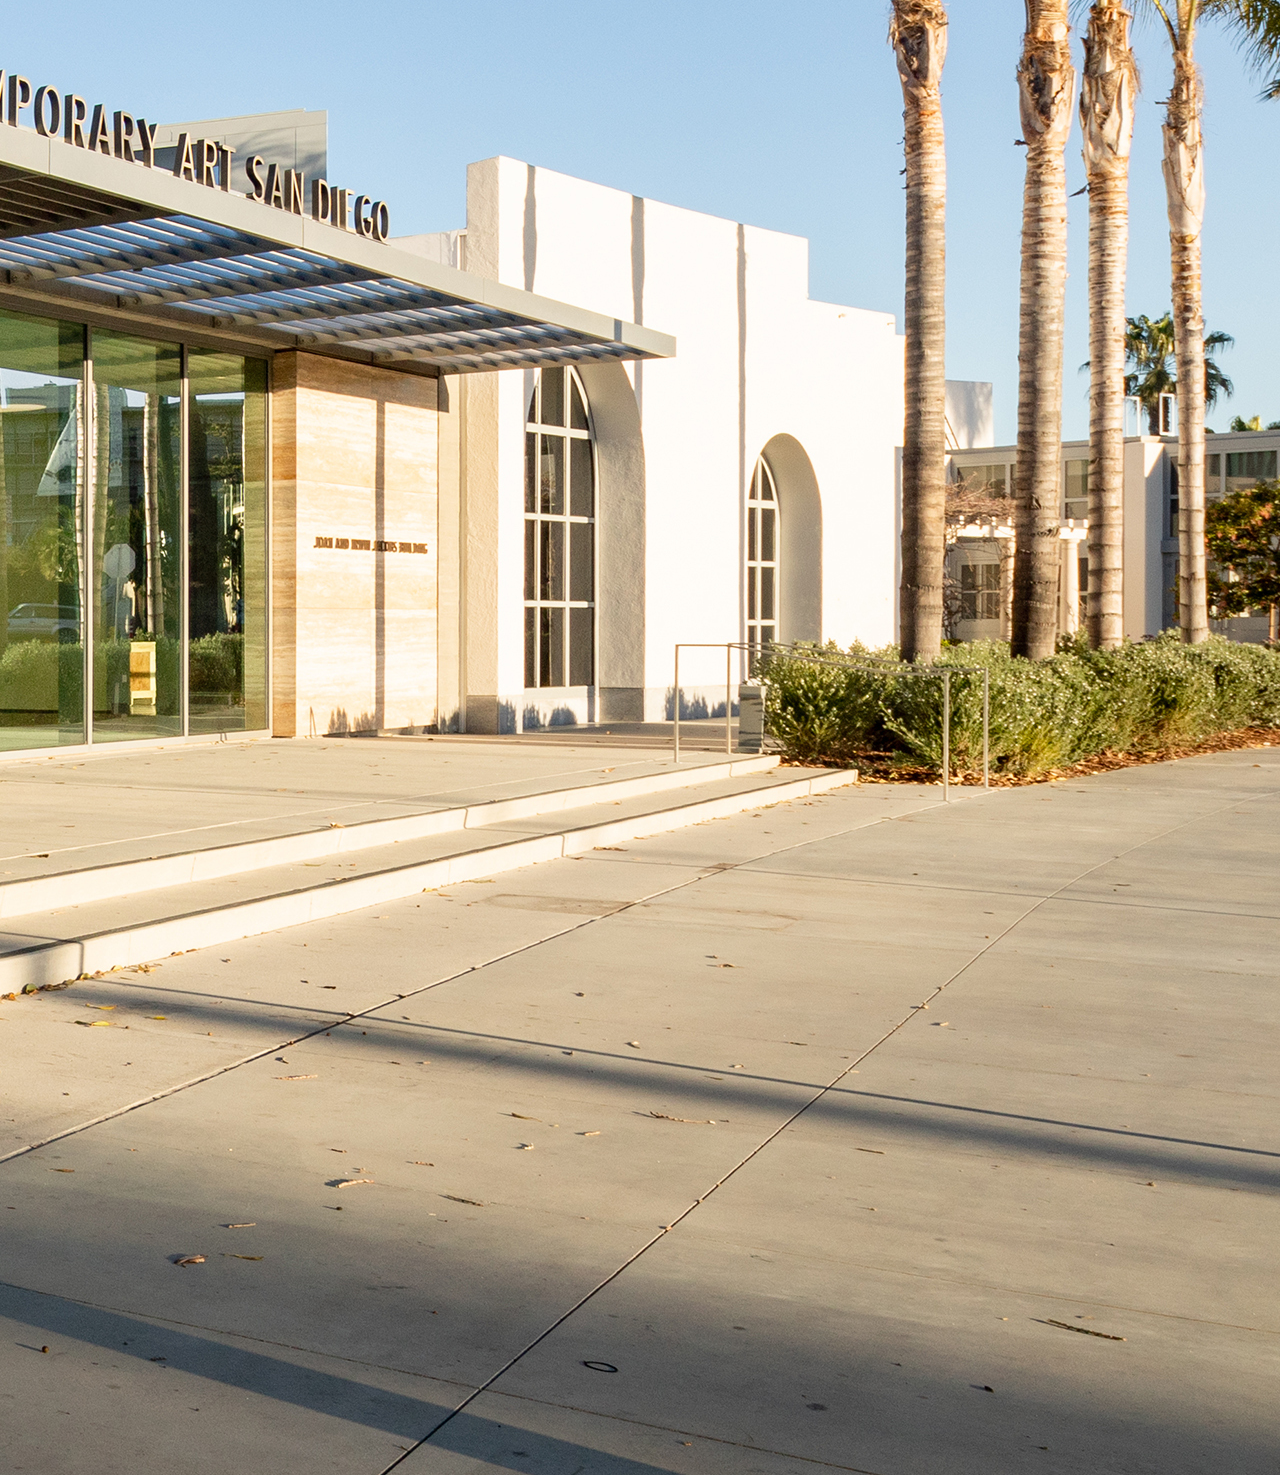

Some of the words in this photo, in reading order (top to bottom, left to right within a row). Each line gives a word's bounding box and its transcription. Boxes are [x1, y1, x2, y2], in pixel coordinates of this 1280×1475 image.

[173, 132, 237, 192] ART
[246, 155, 305, 215] SAN
[311, 178, 391, 243] DIEGO
[334, 538, 350, 550] AND
